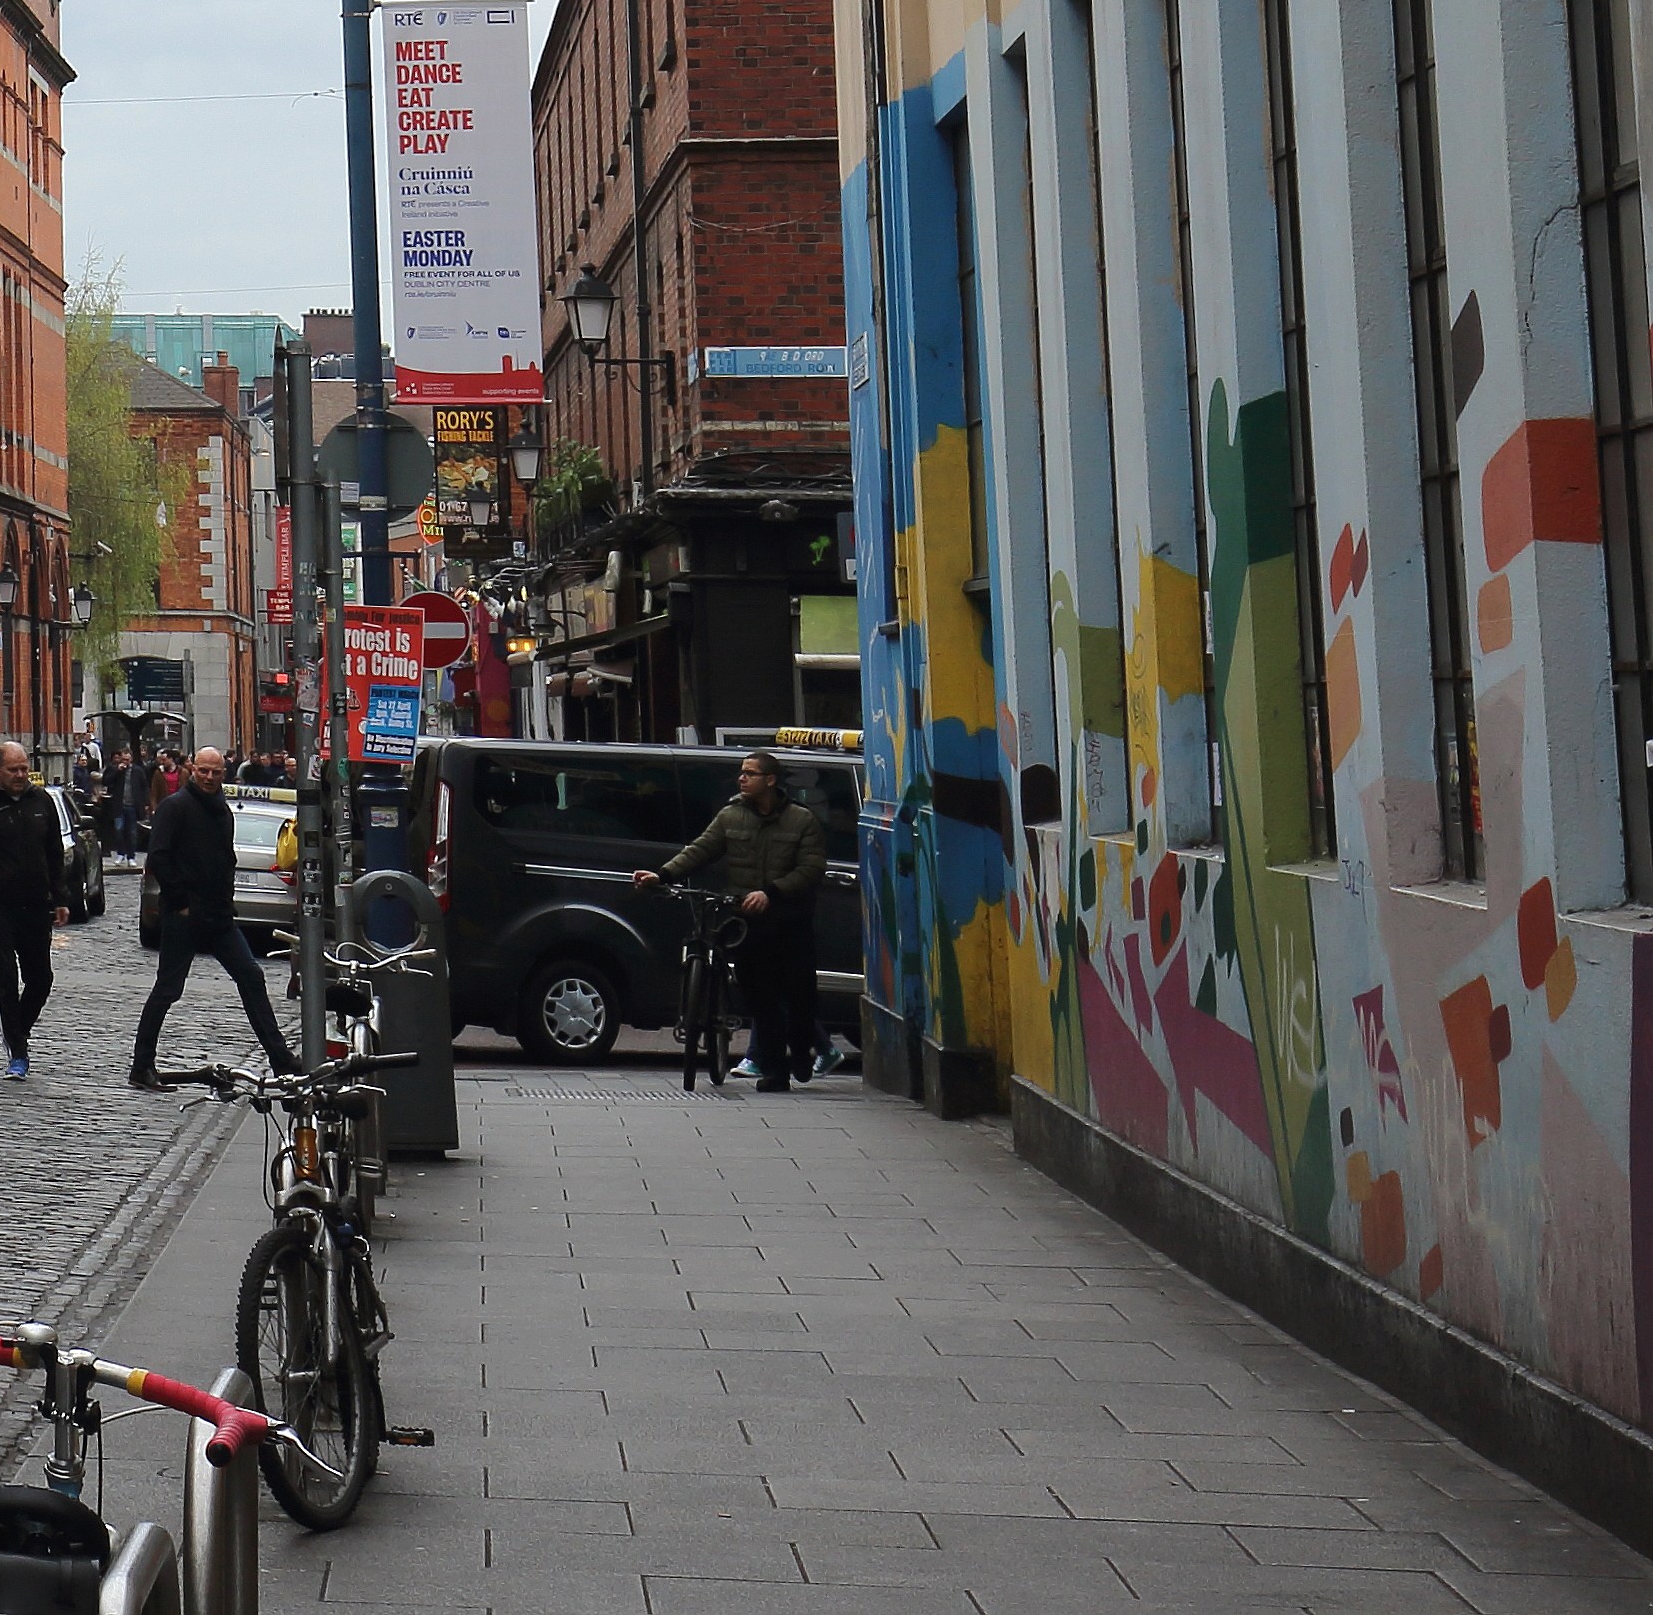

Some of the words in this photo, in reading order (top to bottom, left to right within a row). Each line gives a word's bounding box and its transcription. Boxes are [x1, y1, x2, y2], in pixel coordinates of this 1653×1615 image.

[395, 40, 448, 62] MEET
[396, 63, 463, 85] DANCE
[397, 87, 434, 108] EAT
[398, 110, 474, 132] CREATE
[399, 133, 450, 155] PLAY
[399, 165, 474, 182] Cruinniú
[400, 185, 421, 196] na
[424, 181, 470, 196] Cásca
[402, 230, 466, 248] EASTER
[403, 249, 473, 267] MONDAY
[404, 271, 426, 279] FREE
[457, 270, 475, 278] FOR
[404, 280, 435, 288] DUBLIN
[436, 280, 456, 288] CITY
[457, 280, 491, 288] CENTRE
[746, 363, 802, 374] BEDFORD
[436, 411, 495, 430] RORY'S
[437, 431, 466, 442] FISHING
[469, 431, 493, 442] TACKLE
[344, 628, 391, 652] rotest
[395, 627, 411, 654] is
[356, 655, 366, 677] a
[371, 652, 419, 681] Crime
[241, 786, 269, 798] TAXI
